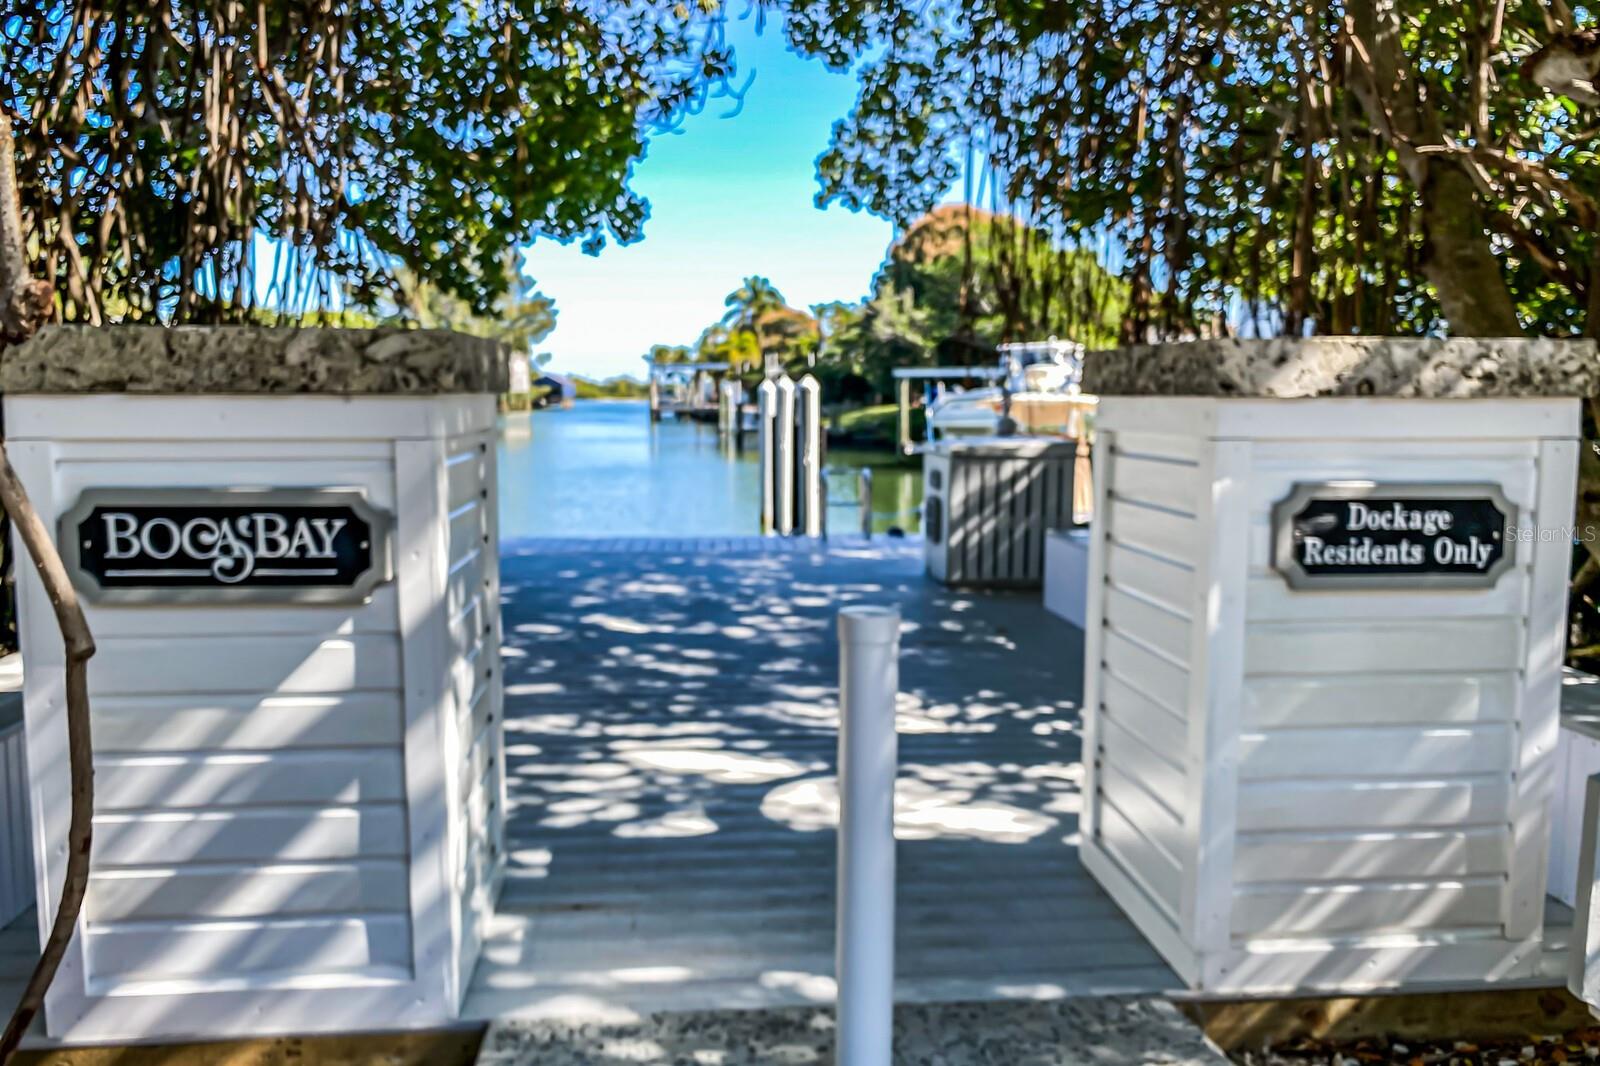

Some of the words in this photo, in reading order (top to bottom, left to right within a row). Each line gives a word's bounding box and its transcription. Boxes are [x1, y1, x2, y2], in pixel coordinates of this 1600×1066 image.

[1347, 502, 1452, 535] Dockage
[252, 513, 347, 559] BAY
[1303, 537, 1424, 565] Residents
[1434, 536, 1493, 569] Only
